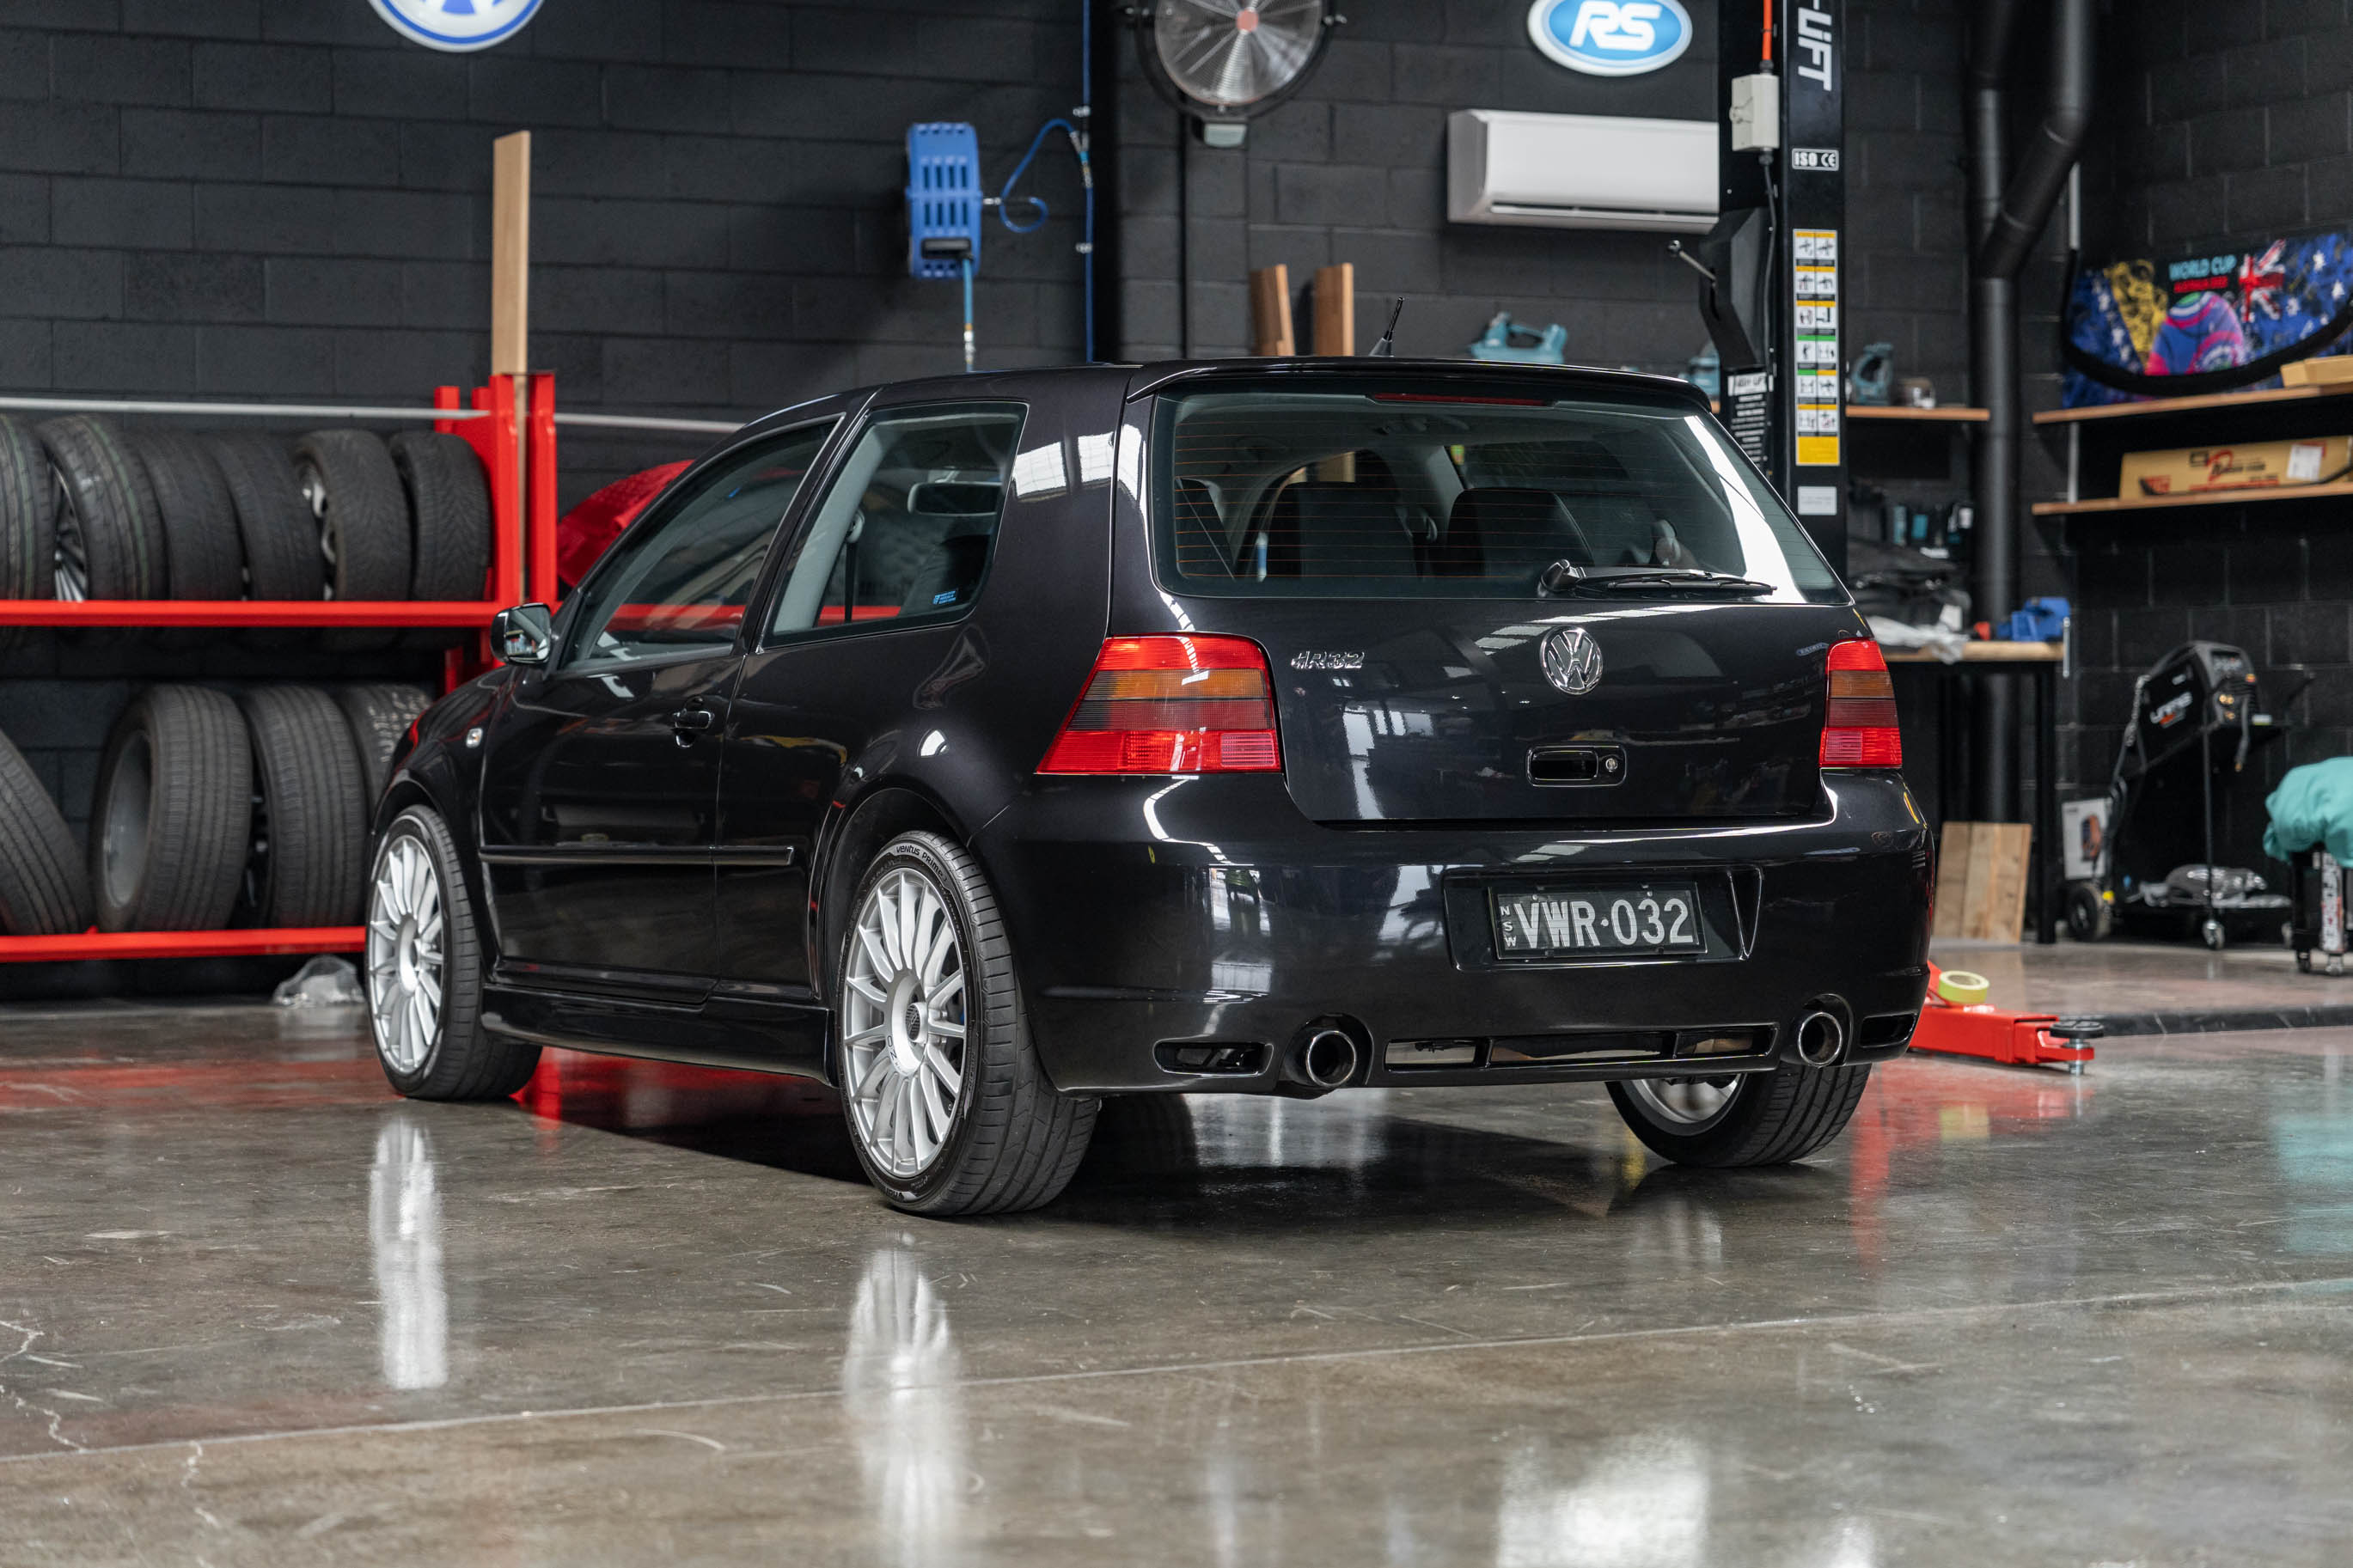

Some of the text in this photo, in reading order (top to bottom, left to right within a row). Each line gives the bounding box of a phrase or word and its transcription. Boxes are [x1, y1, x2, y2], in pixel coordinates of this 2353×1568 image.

[1569, 0, 1662, 52] RS
[1794, 152, 1836, 167] ISO CE
[2168, 254, 2237, 282] WORLD CUP
